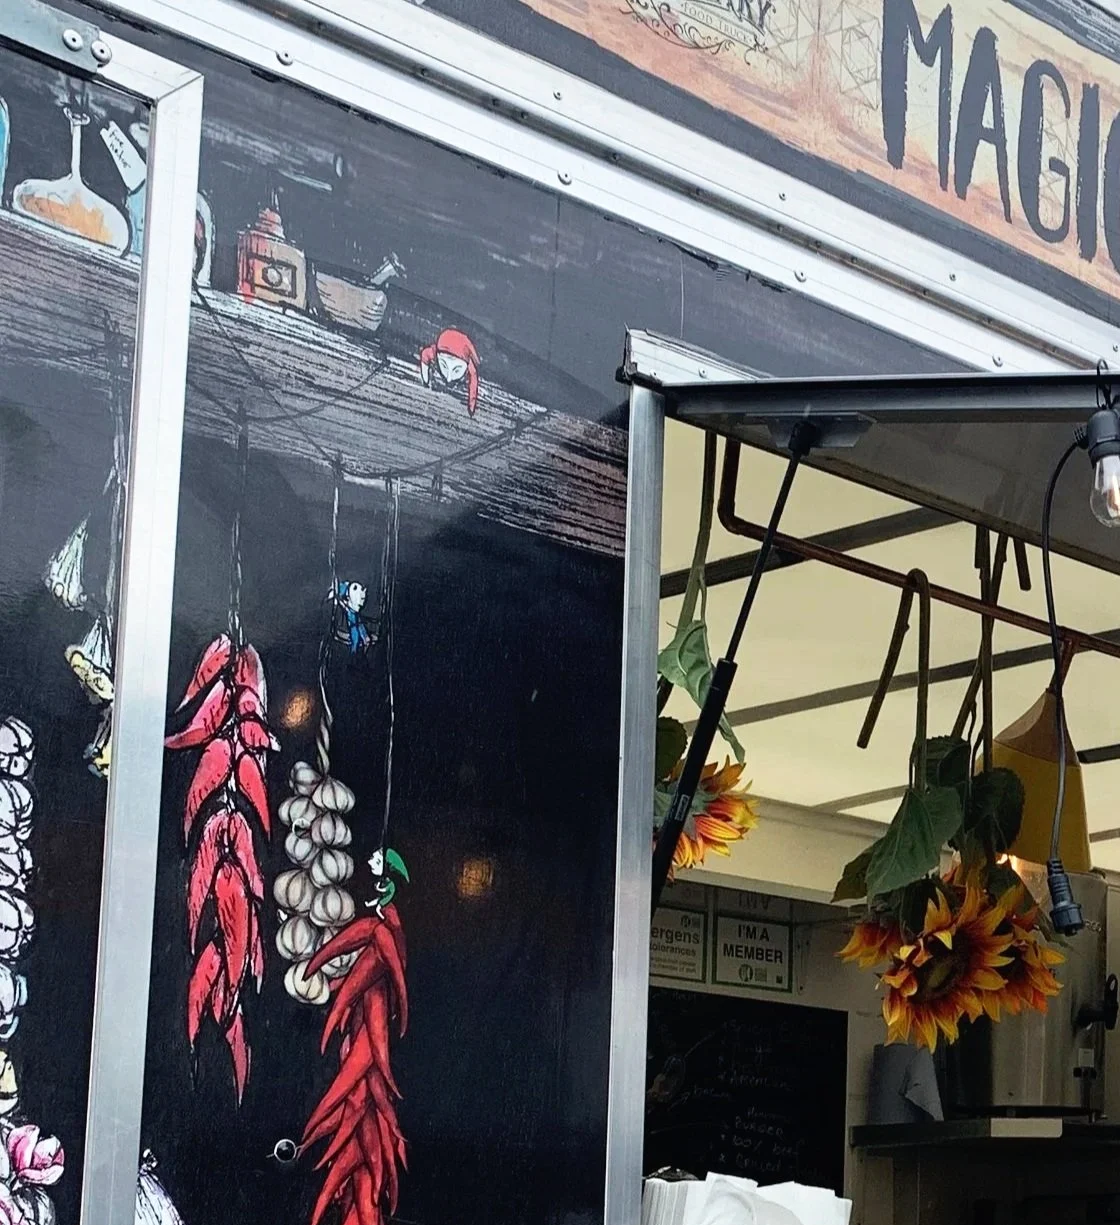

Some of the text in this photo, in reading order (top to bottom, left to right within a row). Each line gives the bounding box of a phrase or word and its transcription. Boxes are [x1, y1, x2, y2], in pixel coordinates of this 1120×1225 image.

[683, 2, 713, 24] FOOD
[719, 21, 750, 44] TRUCK
[737, 924, 770, 942] I'M A
[722, 943, 784, 965] MEMBER
